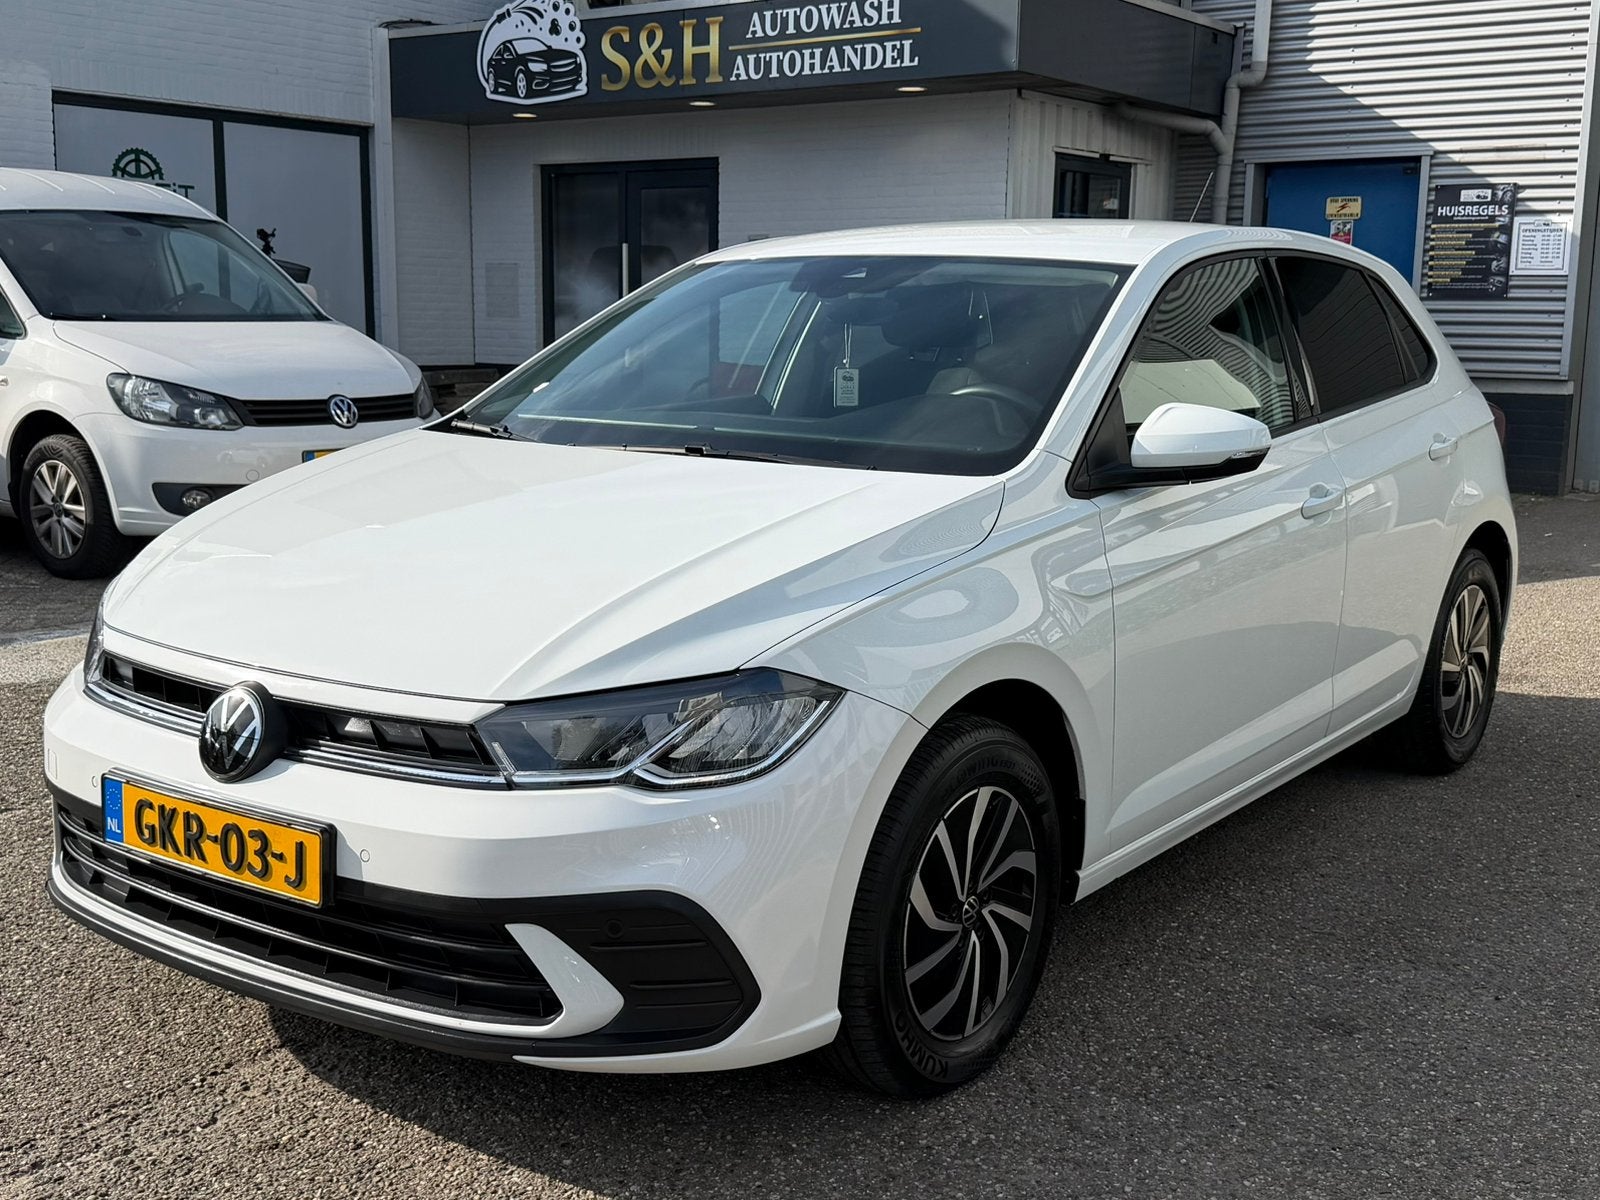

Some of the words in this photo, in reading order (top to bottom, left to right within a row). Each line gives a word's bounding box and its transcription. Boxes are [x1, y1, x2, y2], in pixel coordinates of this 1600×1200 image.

[746, 0, 902, 39] AUTOWASH
[600, 16, 724, 91] S&H
[729, 39, 919, 82] AUTOHANDEL
[1437, 204, 1509, 217] HUISREGELS
[107, 817, 122, 834] NL
[134, 798, 307, 892] GKR-03-J
